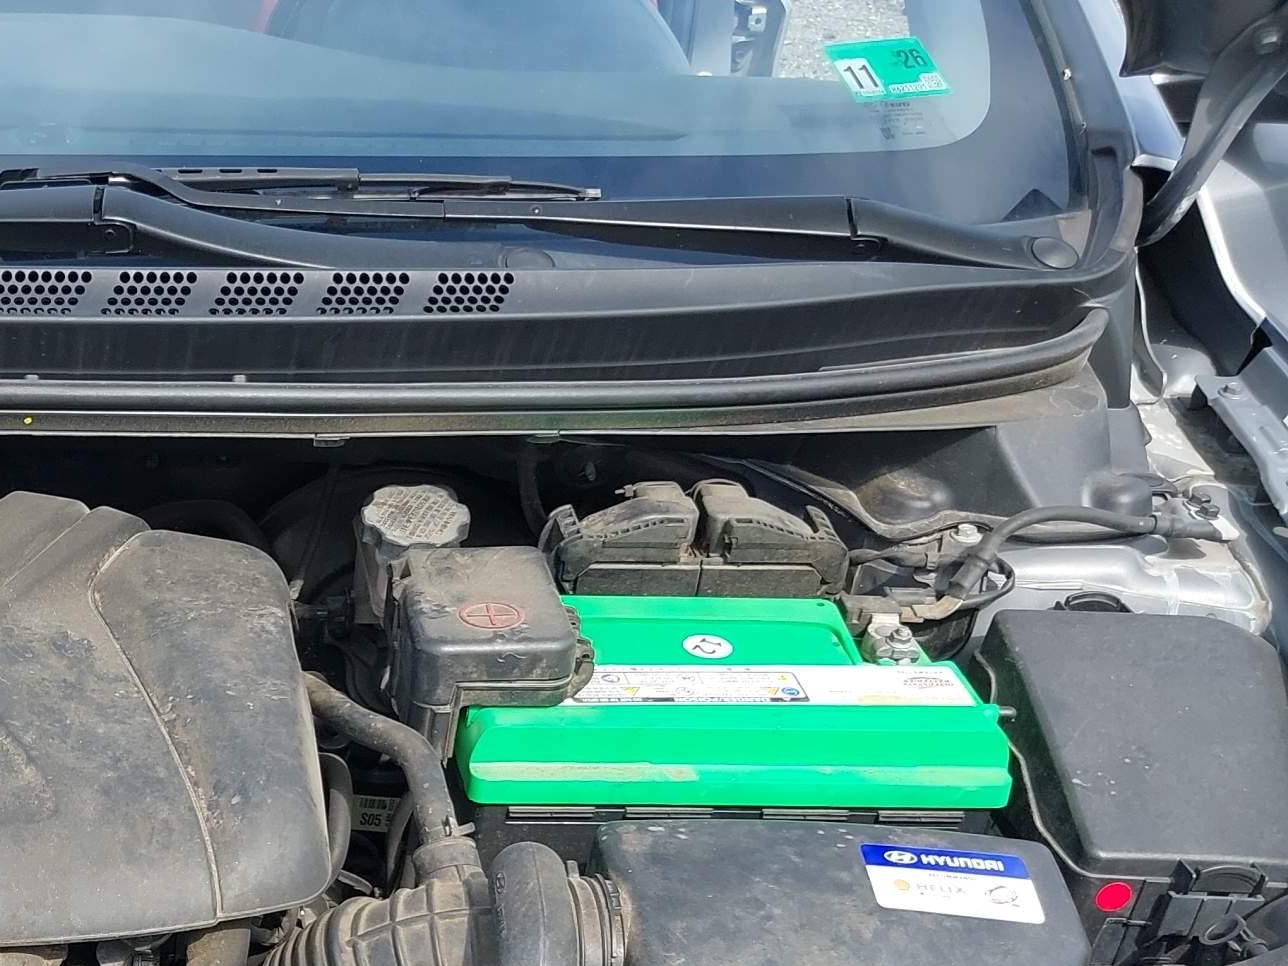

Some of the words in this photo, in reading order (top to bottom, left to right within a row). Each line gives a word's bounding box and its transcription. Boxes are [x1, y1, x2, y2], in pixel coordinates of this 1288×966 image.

[896, 48, 928, 69] 26
[843, 64, 879, 90] 11
[920, 852, 1006, 872] HYUNDAI
